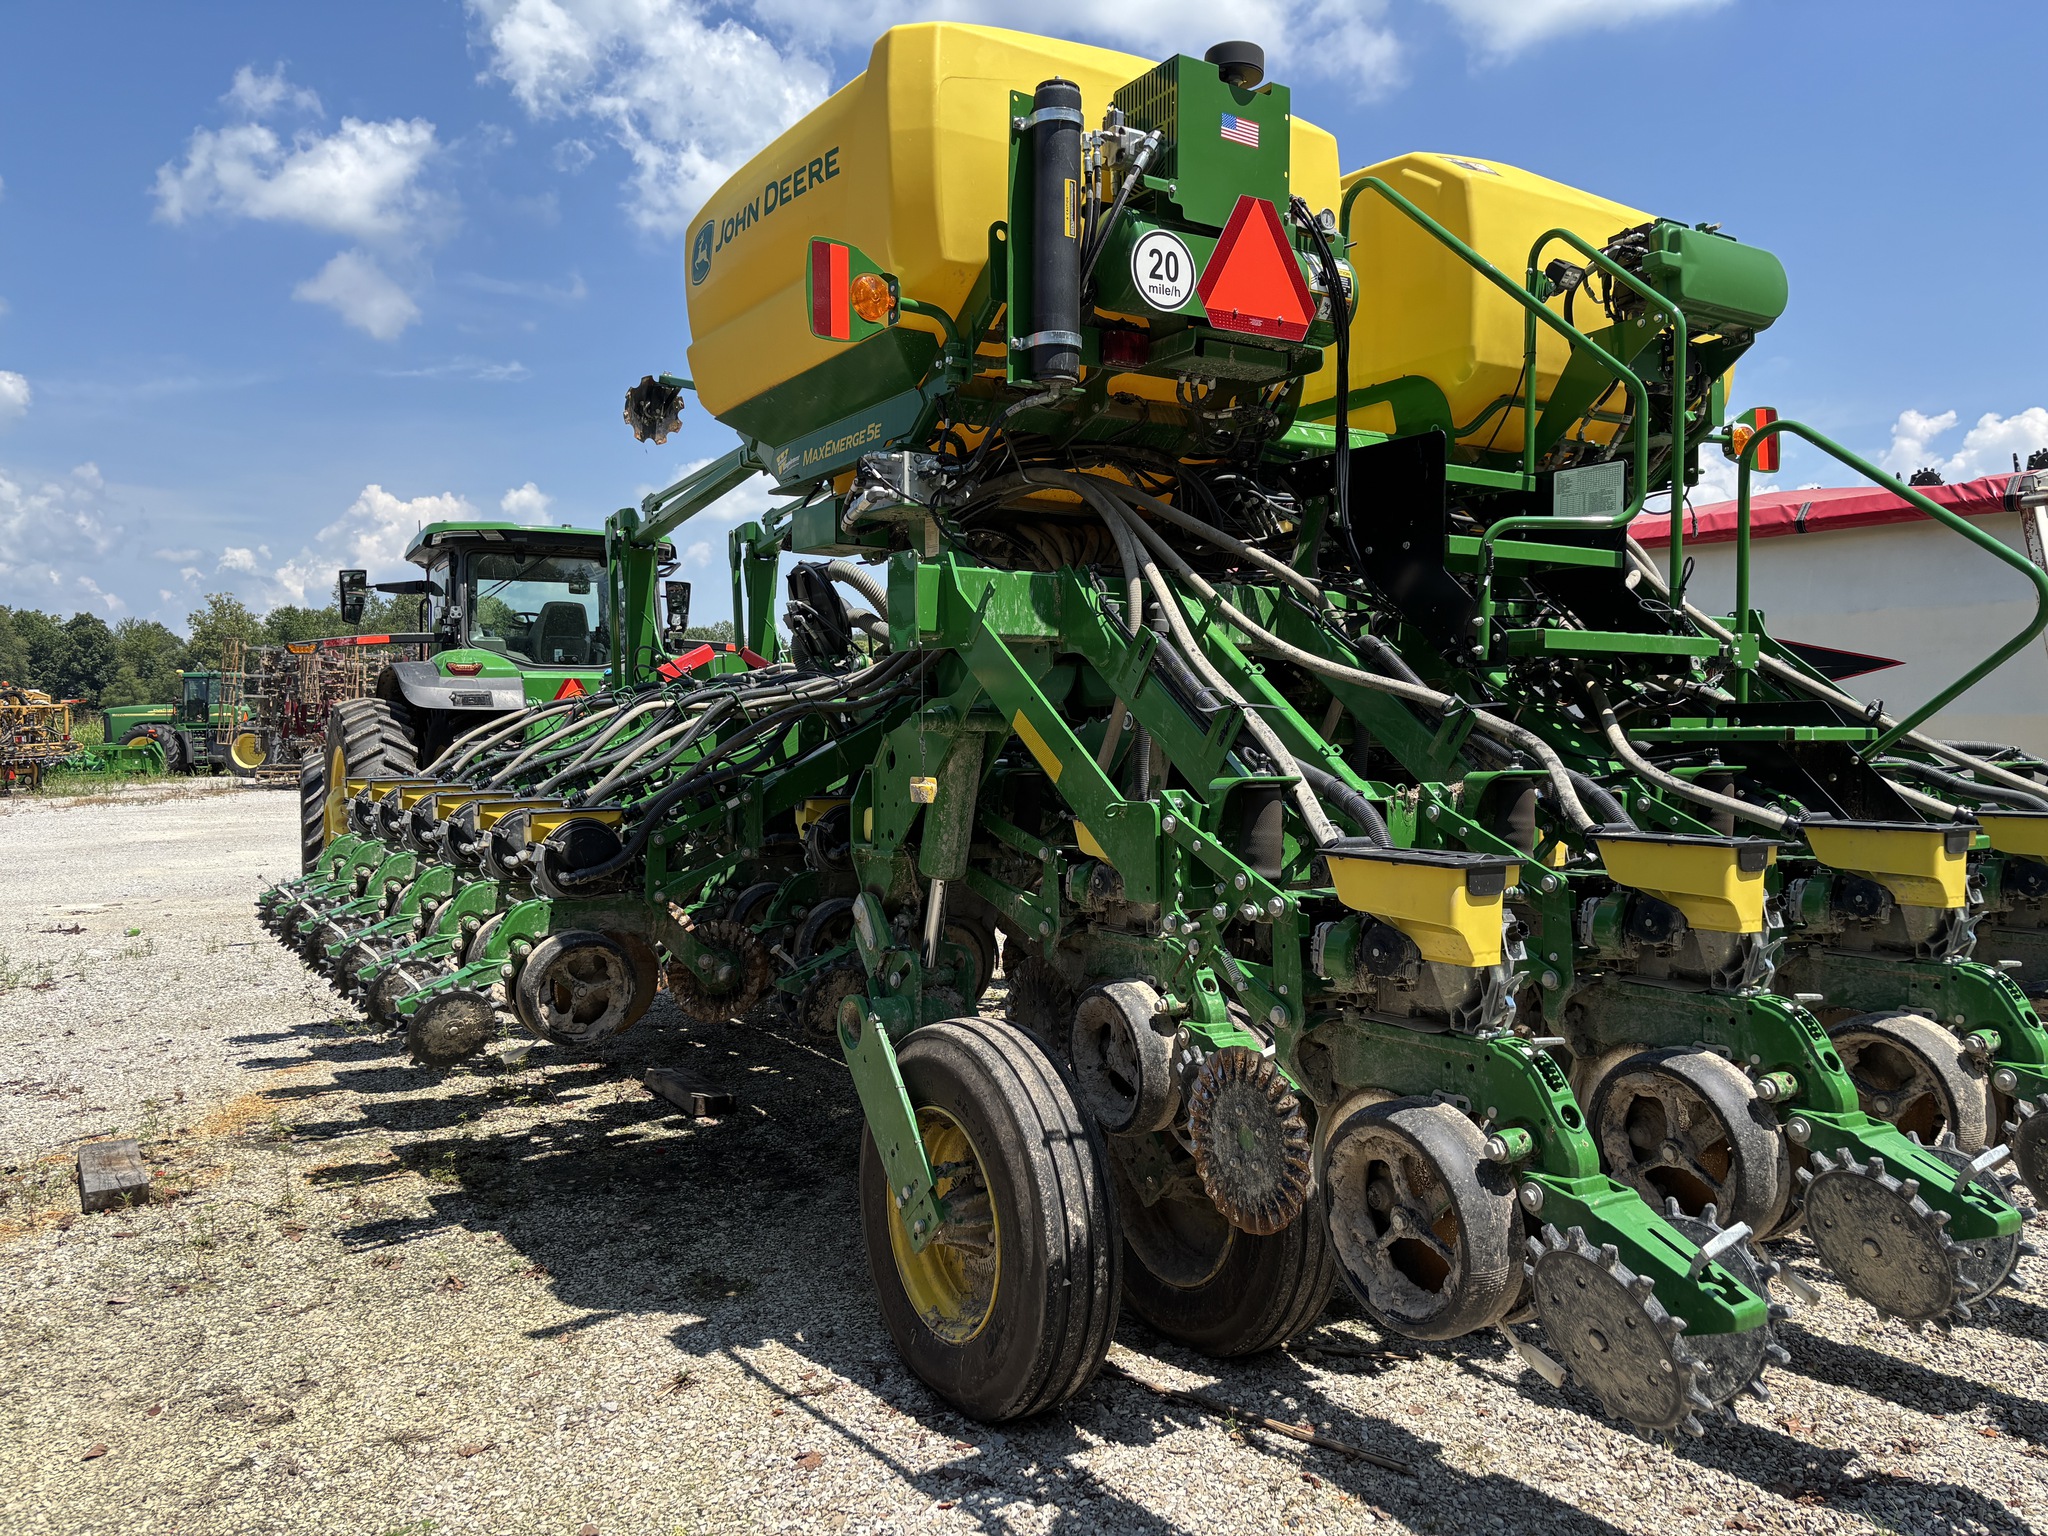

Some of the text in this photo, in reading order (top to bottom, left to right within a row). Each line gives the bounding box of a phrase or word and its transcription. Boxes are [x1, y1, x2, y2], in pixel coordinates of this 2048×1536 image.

[715, 146, 841, 253] JOHN DEERE
[1148, 248, 1179, 282] 20
[1148, 283, 1181, 298] mile/h
